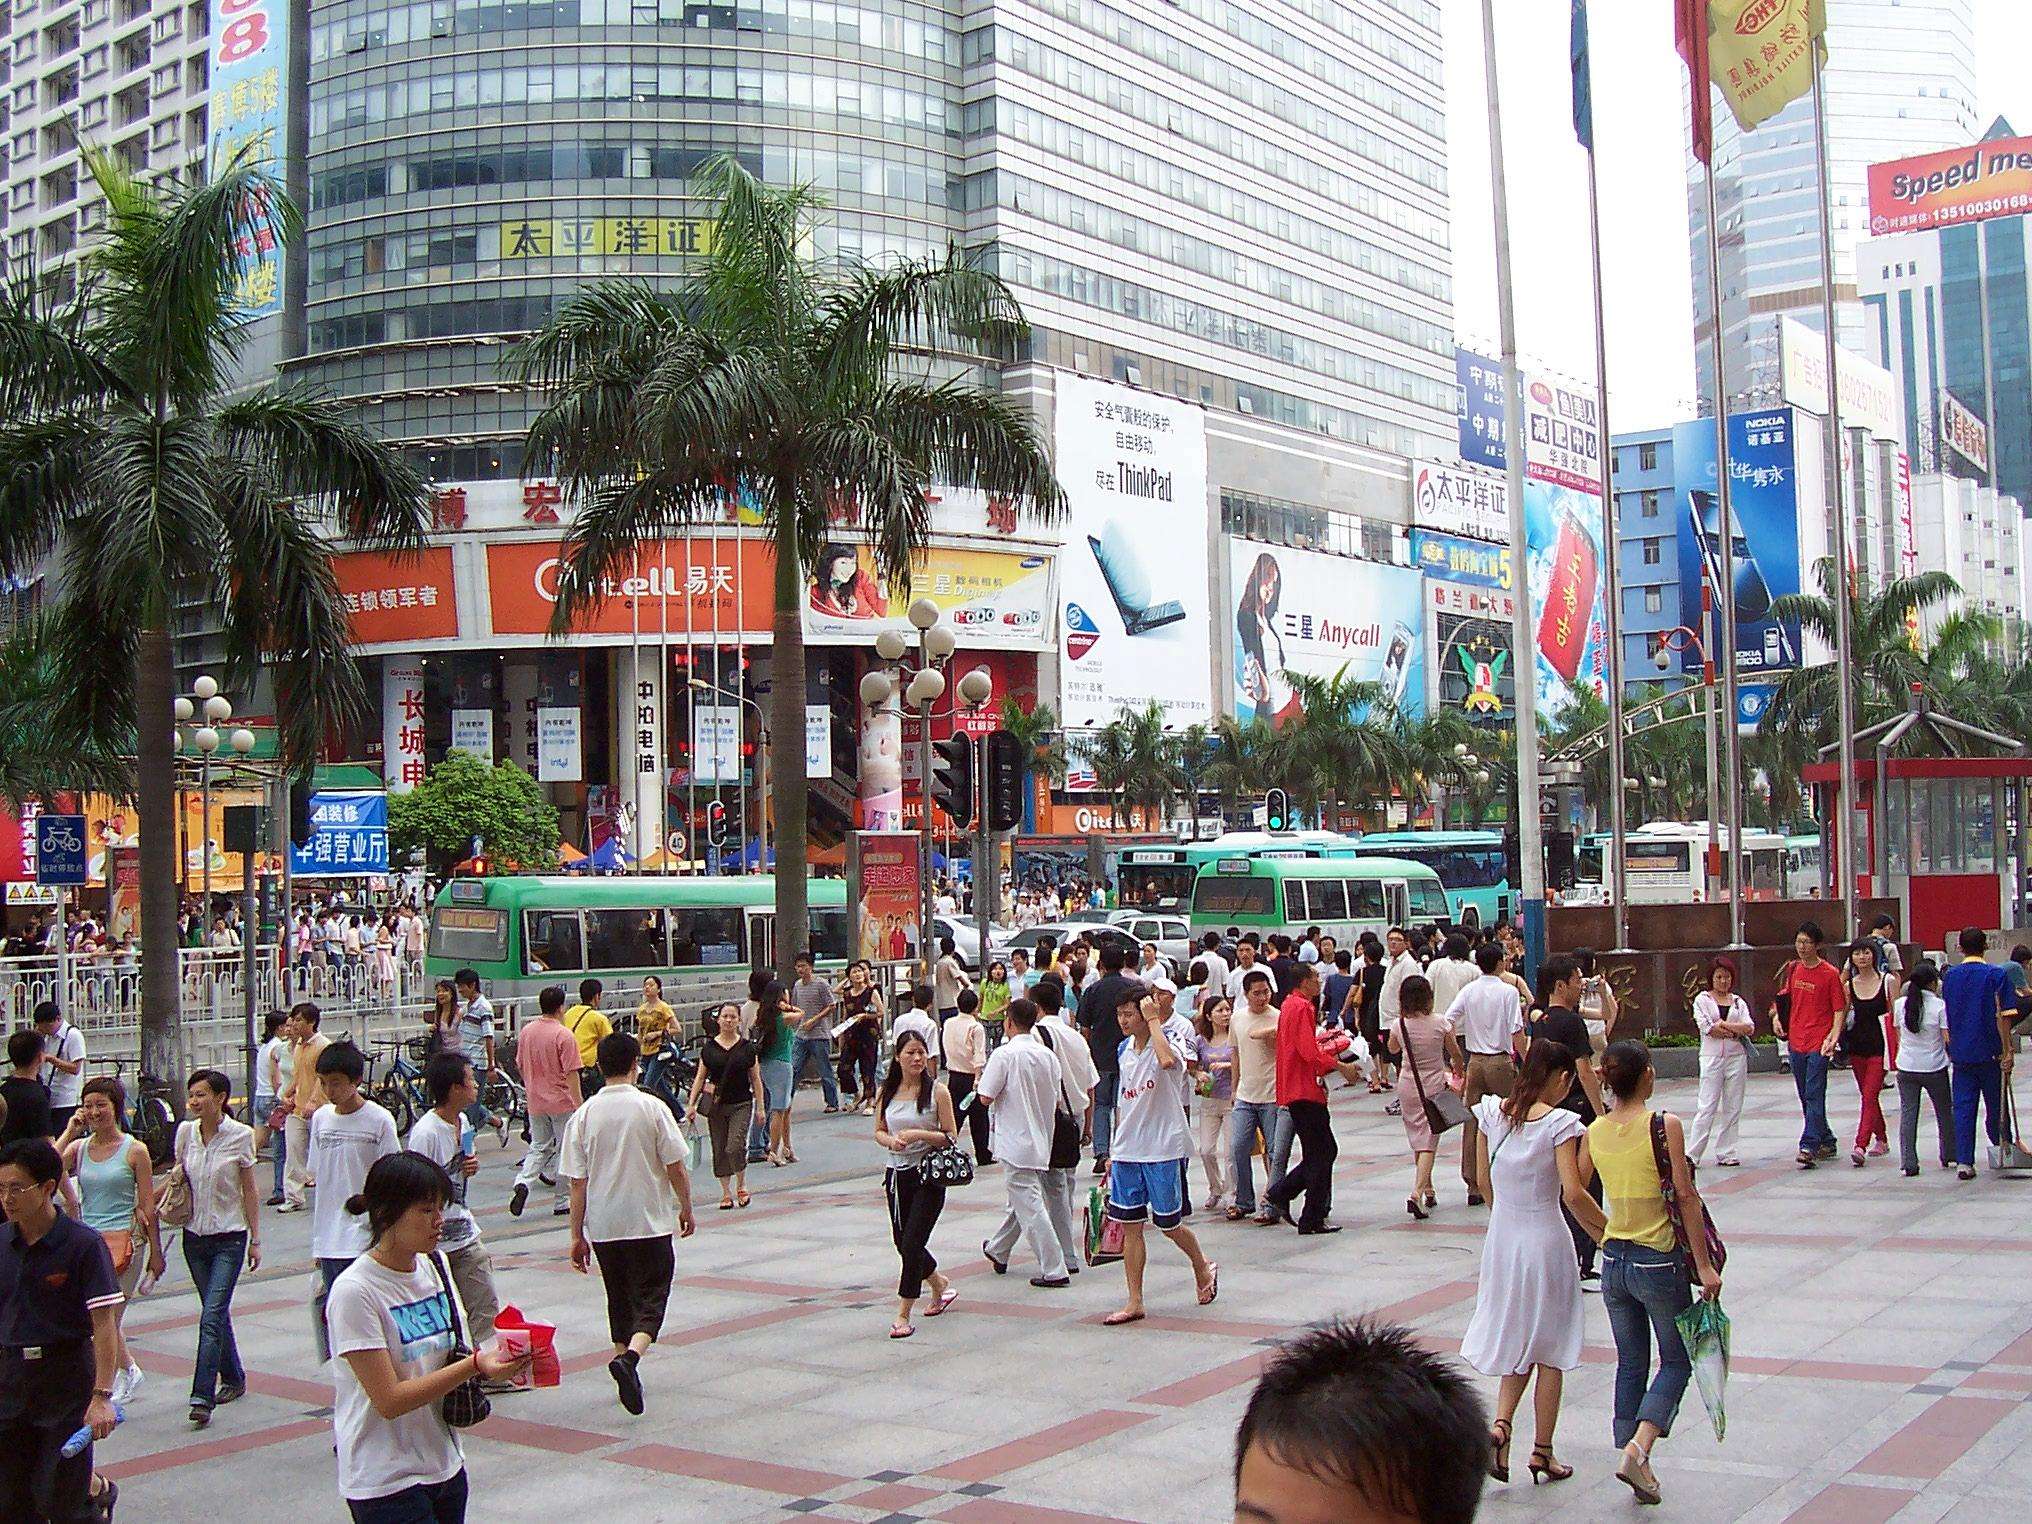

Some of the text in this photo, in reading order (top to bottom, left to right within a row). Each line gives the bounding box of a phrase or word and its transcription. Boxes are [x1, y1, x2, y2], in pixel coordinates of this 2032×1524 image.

[1891, 150, 1983, 205] Speed
[509, 220, 701, 256] 太平洋证
[1745, 416, 1786, 428] NOKIA
[1747, 431, 1786, 446] 诺基亚
[1116, 461, 1173, 502] ThinkPad
[684, 565, 734, 595] 易天
[912, 574, 951, 596] 三星
[1284, 613, 1380, 650] 三星 Anycall
[295, 831, 390, 865] 华强营业厅
